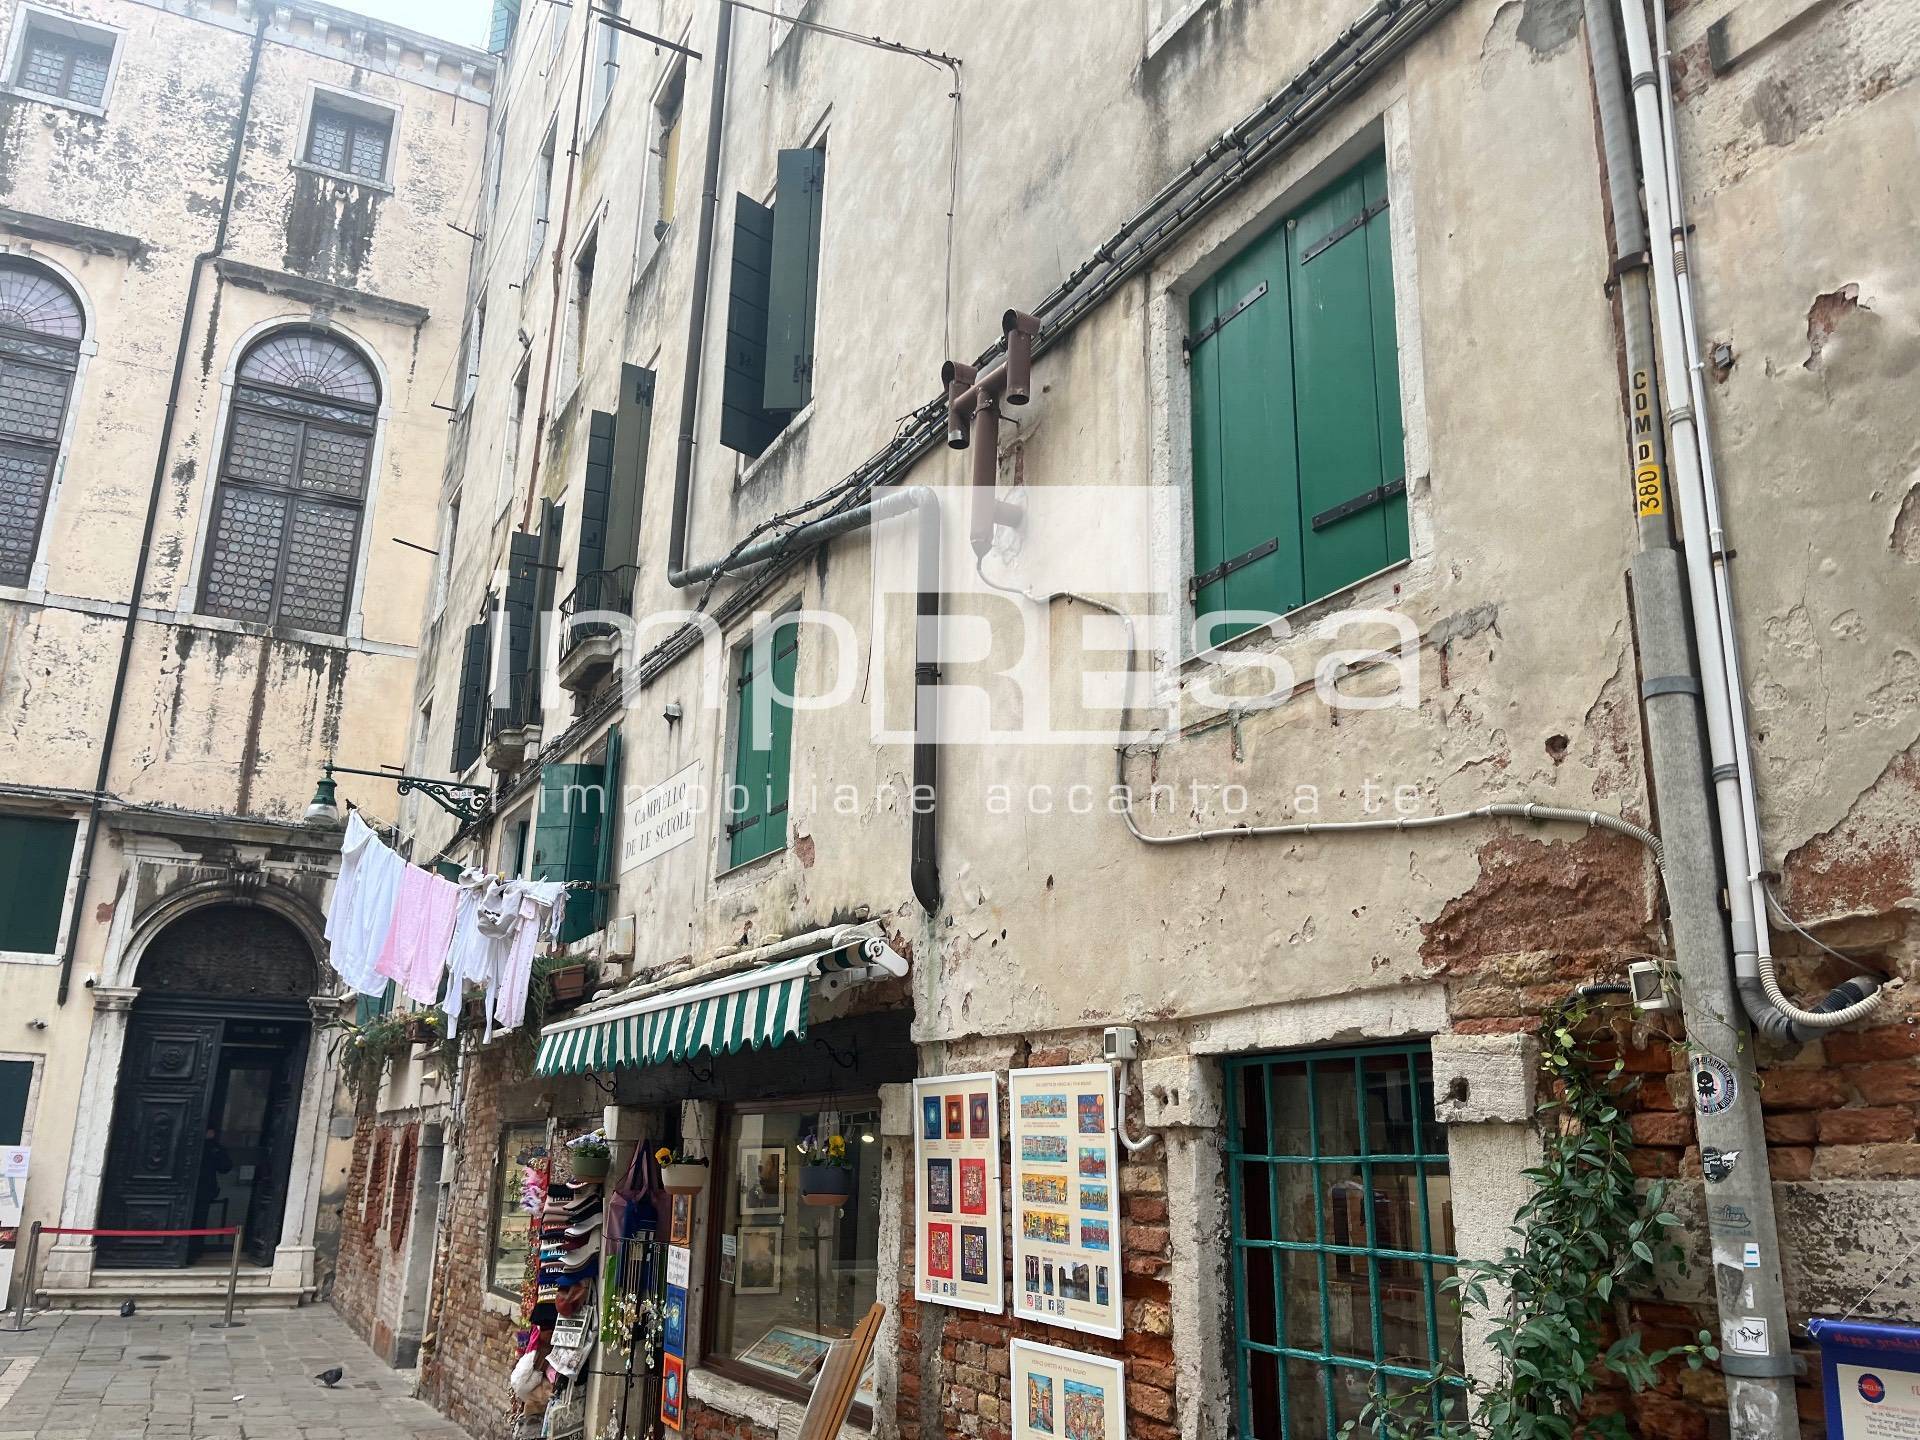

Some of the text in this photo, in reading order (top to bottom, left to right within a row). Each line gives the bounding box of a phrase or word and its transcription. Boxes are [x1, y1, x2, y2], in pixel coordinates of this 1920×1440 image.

[634, 782, 687, 827] CAMPIELLO
[625, 807, 692, 860] DE LE SCUOLE
